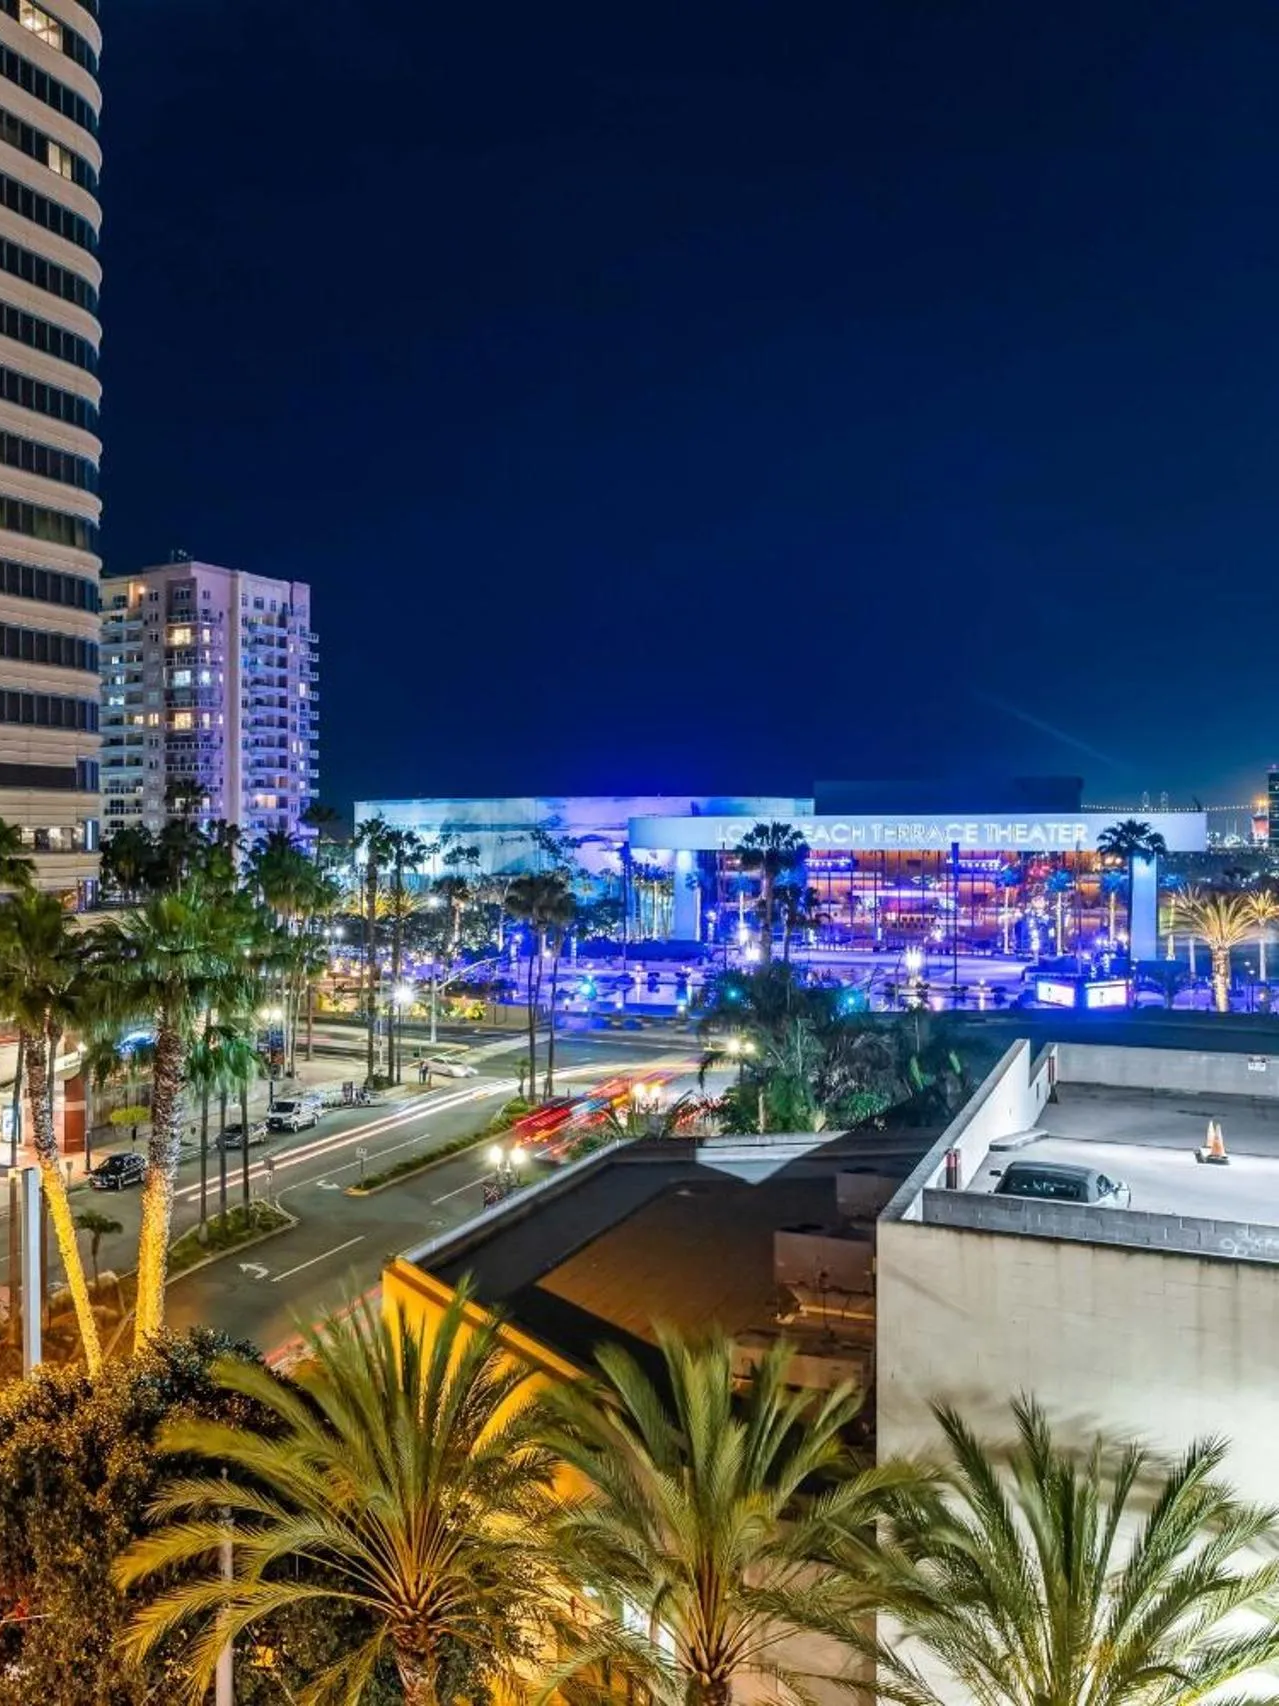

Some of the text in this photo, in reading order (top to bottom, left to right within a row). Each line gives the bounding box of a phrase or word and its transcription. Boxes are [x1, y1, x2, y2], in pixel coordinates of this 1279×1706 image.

[715, 823, 1088, 844] LO EACH TERRACE THEATER
